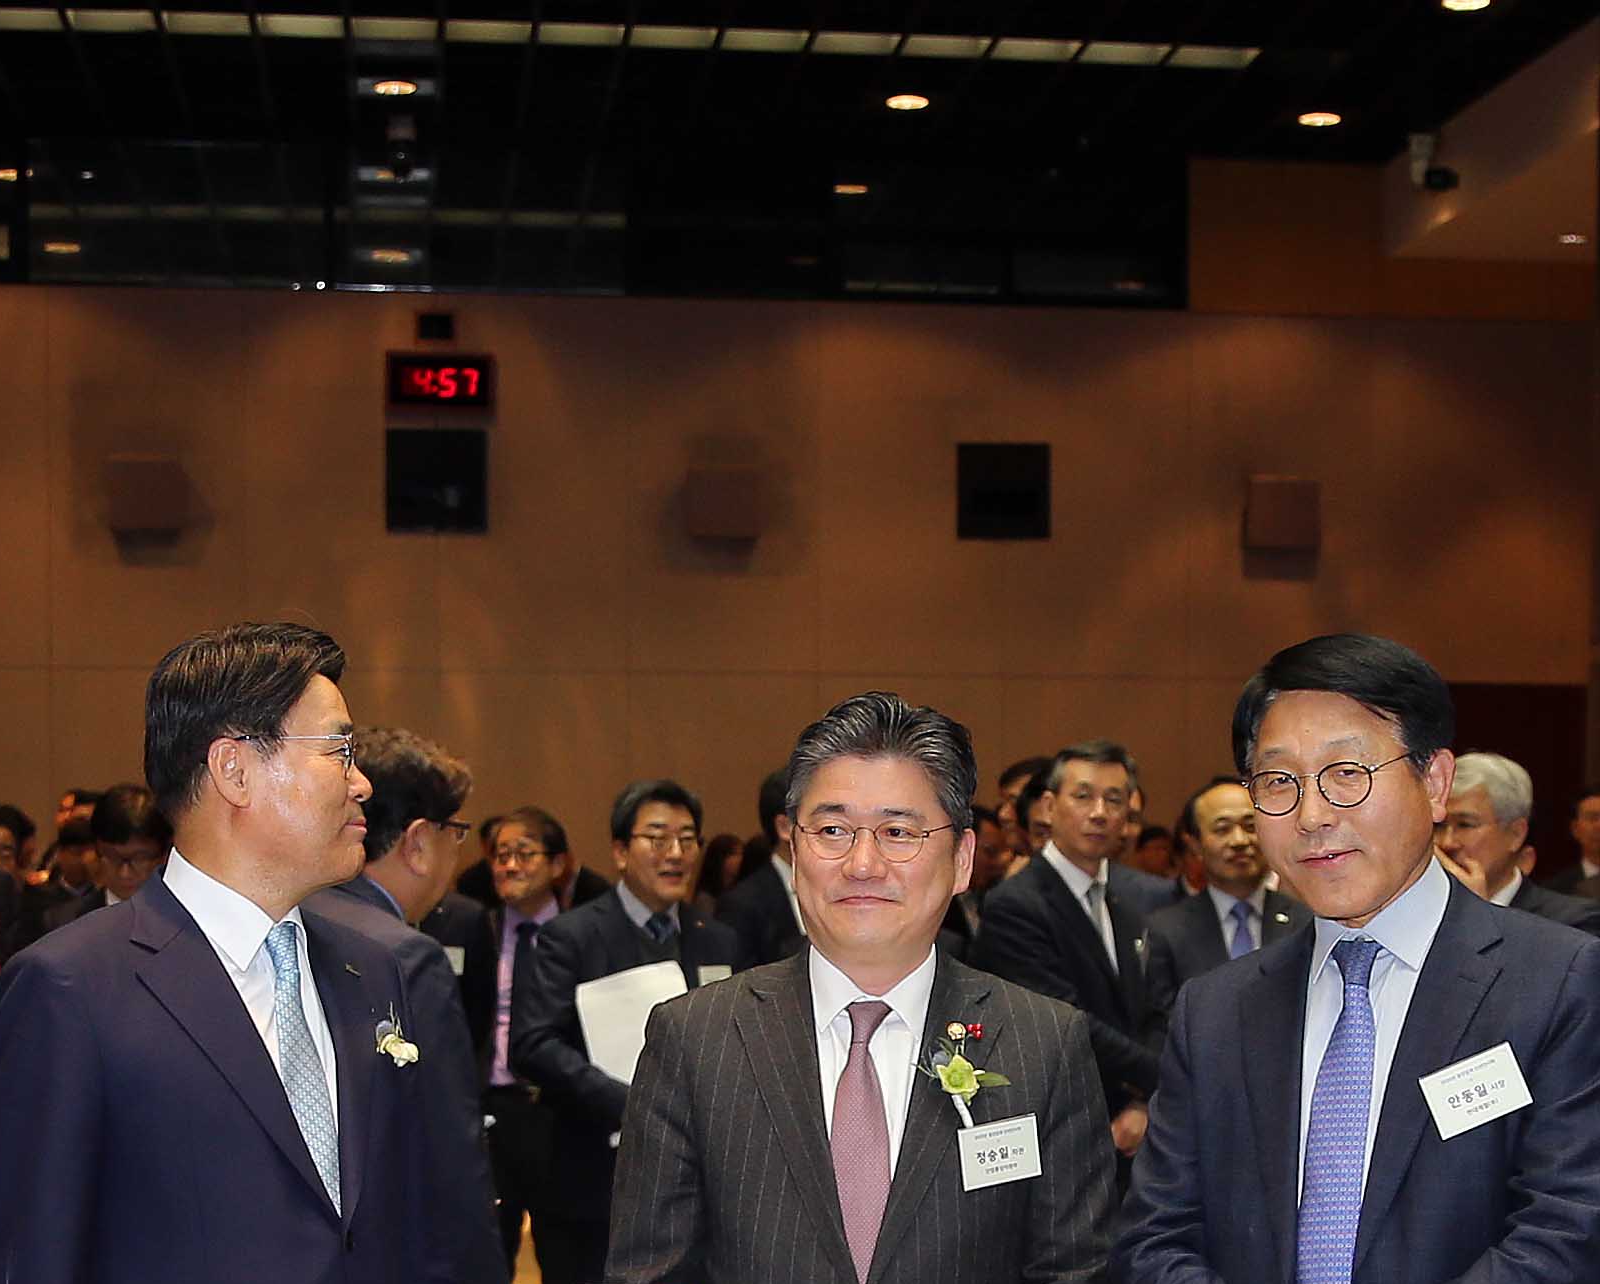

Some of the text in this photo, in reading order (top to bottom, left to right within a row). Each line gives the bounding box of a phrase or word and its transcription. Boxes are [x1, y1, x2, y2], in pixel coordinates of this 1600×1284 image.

[412, 367, 480, 398] 4:57
[1447, 1082, 1489, 1110] 안동일
[976, 1146, 1009, 1165] 정승일
